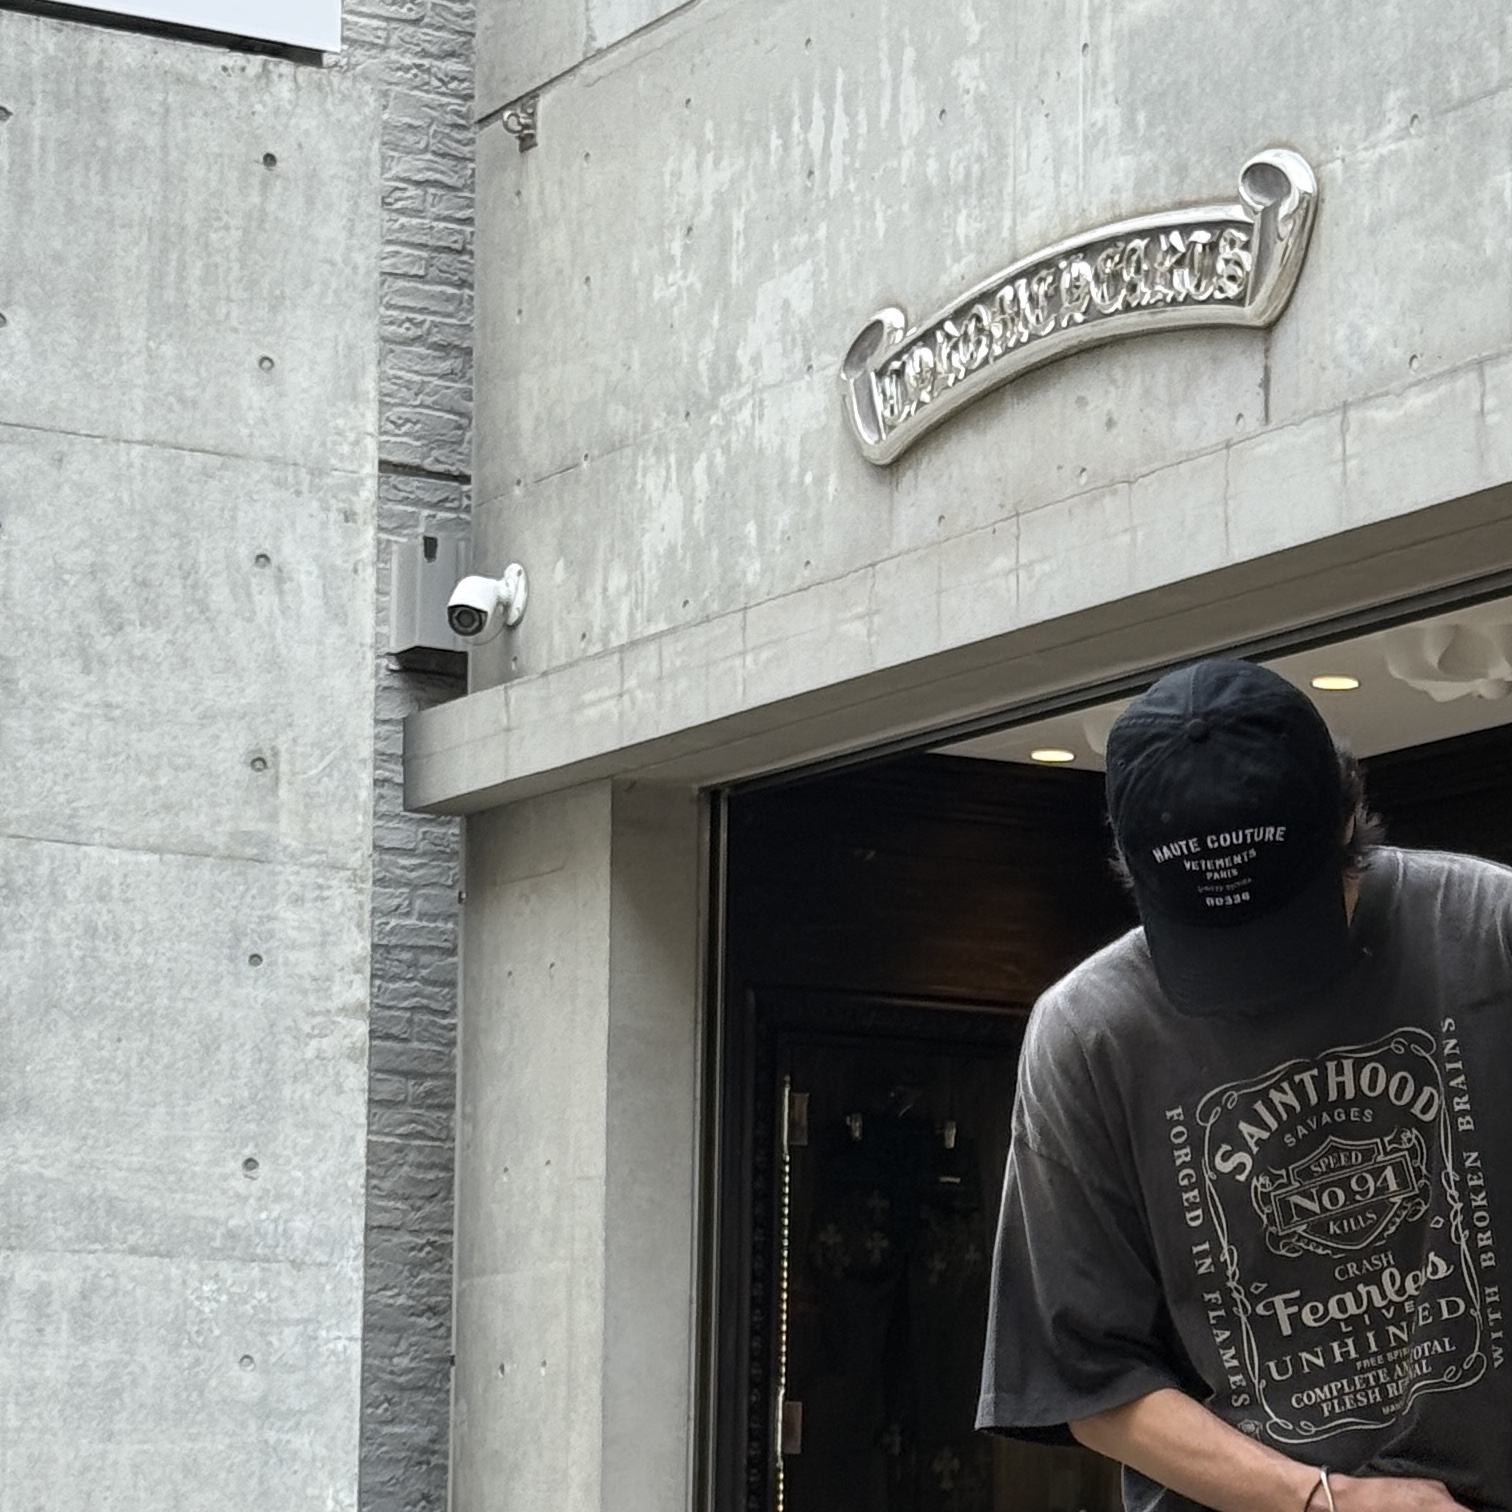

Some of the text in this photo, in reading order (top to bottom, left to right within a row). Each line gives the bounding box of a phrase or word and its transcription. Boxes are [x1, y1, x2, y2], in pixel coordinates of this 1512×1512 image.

[1152, 826, 1287, 864] HAUTE COUTURE
[1183, 848, 1257, 871] VETEMENTS
[1206, 868, 1239, 881] PARIS
[1214, 1058, 1440, 1182] SAINTHOOD
[1283, 1107, 1374, 1148] SAVAGES
[1310, 1151, 1363, 1177] SPEED
[1350, 1165, 1401, 1201] 94
[1441, 1017, 1505, 1369] WITH BROKEN BRAINS
[1328, 1210, 1378, 1235] KILLS
[1165, 1105, 1250, 1409] FORGED IN FLAMES
[1334, 1251, 1396, 1281] CRASH
[1340, 1300, 1415, 1333] LIVE
[1265, 1297, 1466, 1381] UNHINED
[1291, 1367, 1391, 1409] COMPLETE
[1321, 1388, 1382, 1418] FLESH
